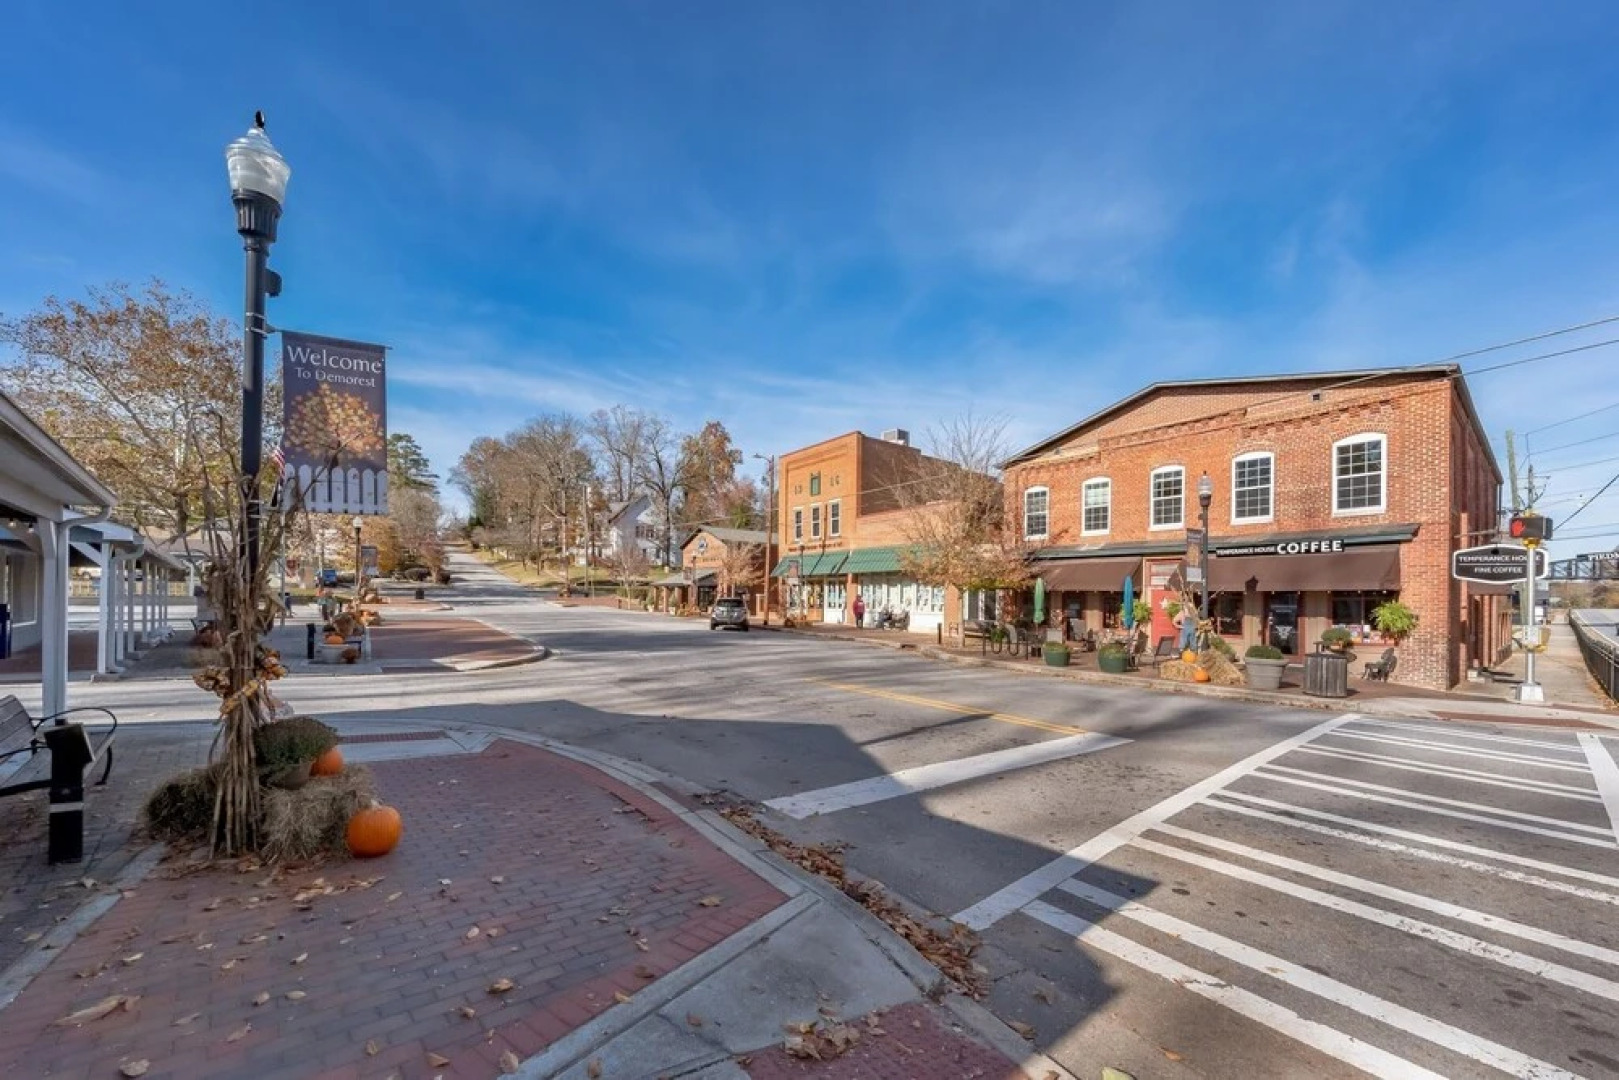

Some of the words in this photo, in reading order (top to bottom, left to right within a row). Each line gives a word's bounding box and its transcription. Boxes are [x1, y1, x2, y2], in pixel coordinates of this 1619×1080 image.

[287, 345, 382, 374] Welcome
[295, 366, 312, 380] To
[315, 369, 376, 388] Demorest
[1276, 540, 1342, 554] COFFEE
[1474, 566, 1492, 574] FINE
[1492, 566, 1523, 574] COFFEE
